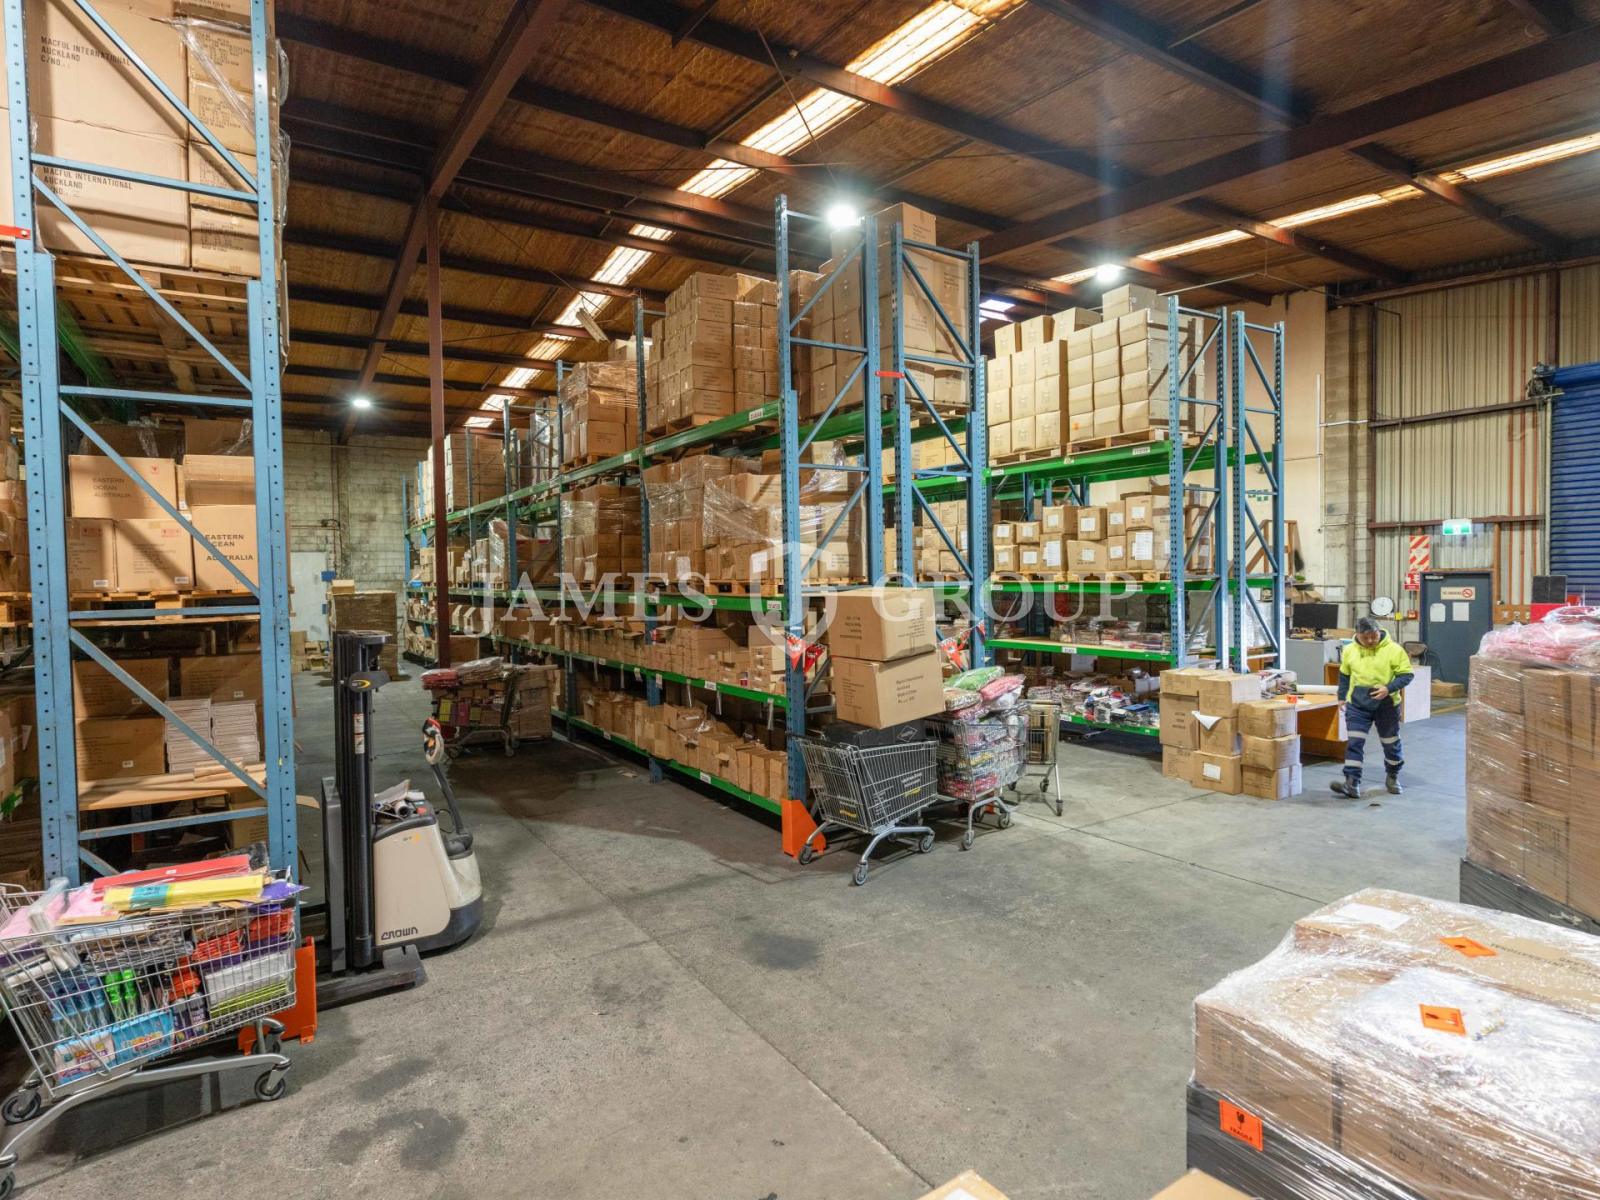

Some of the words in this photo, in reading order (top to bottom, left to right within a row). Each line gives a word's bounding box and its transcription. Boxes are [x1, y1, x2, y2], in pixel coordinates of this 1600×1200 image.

[41, 36, 70, 50] MACFUL
[41, 46, 80, 62] AUCKLAND
[43, 175, 83, 189] AUCKLAND
[75, 172, 134, 190] INTERNATIONAL
[381, 926, 418, 941] CROWN
